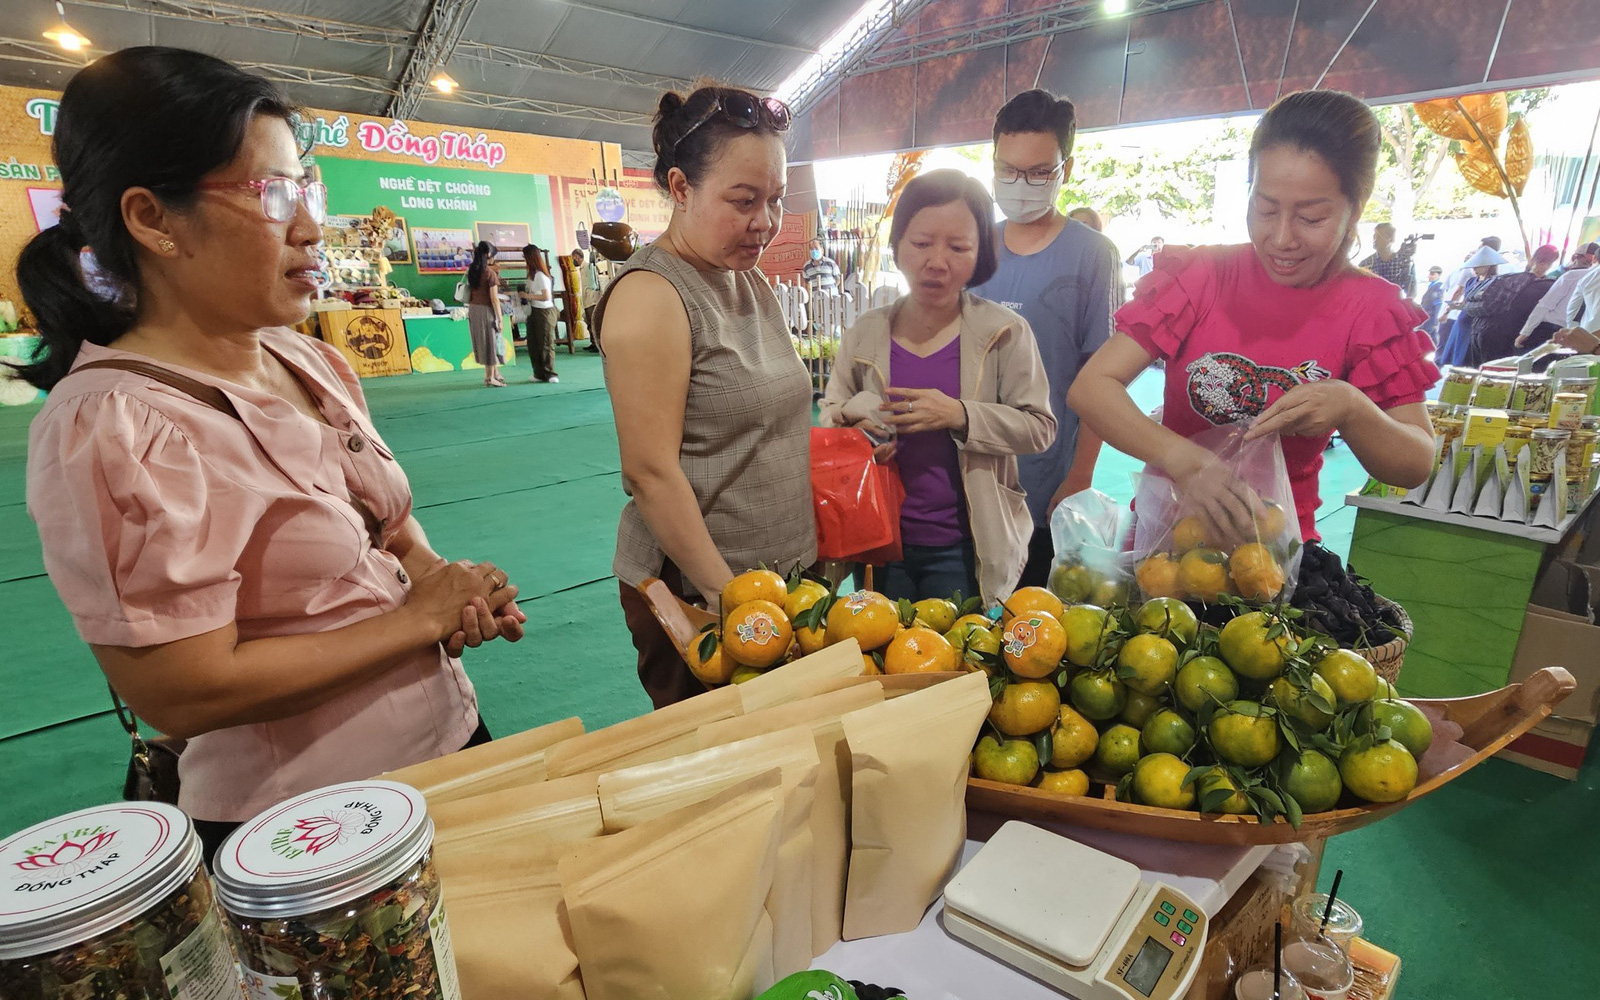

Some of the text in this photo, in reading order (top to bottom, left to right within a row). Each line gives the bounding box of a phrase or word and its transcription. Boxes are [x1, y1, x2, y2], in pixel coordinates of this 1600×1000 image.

[359, 120, 440, 164] Đồng
[442, 131, 505, 167] Tháp
[379, 176, 491, 196] NGHỀ DỆT CHOÀNG
[401, 196, 478, 211] LONG KHÁNH
